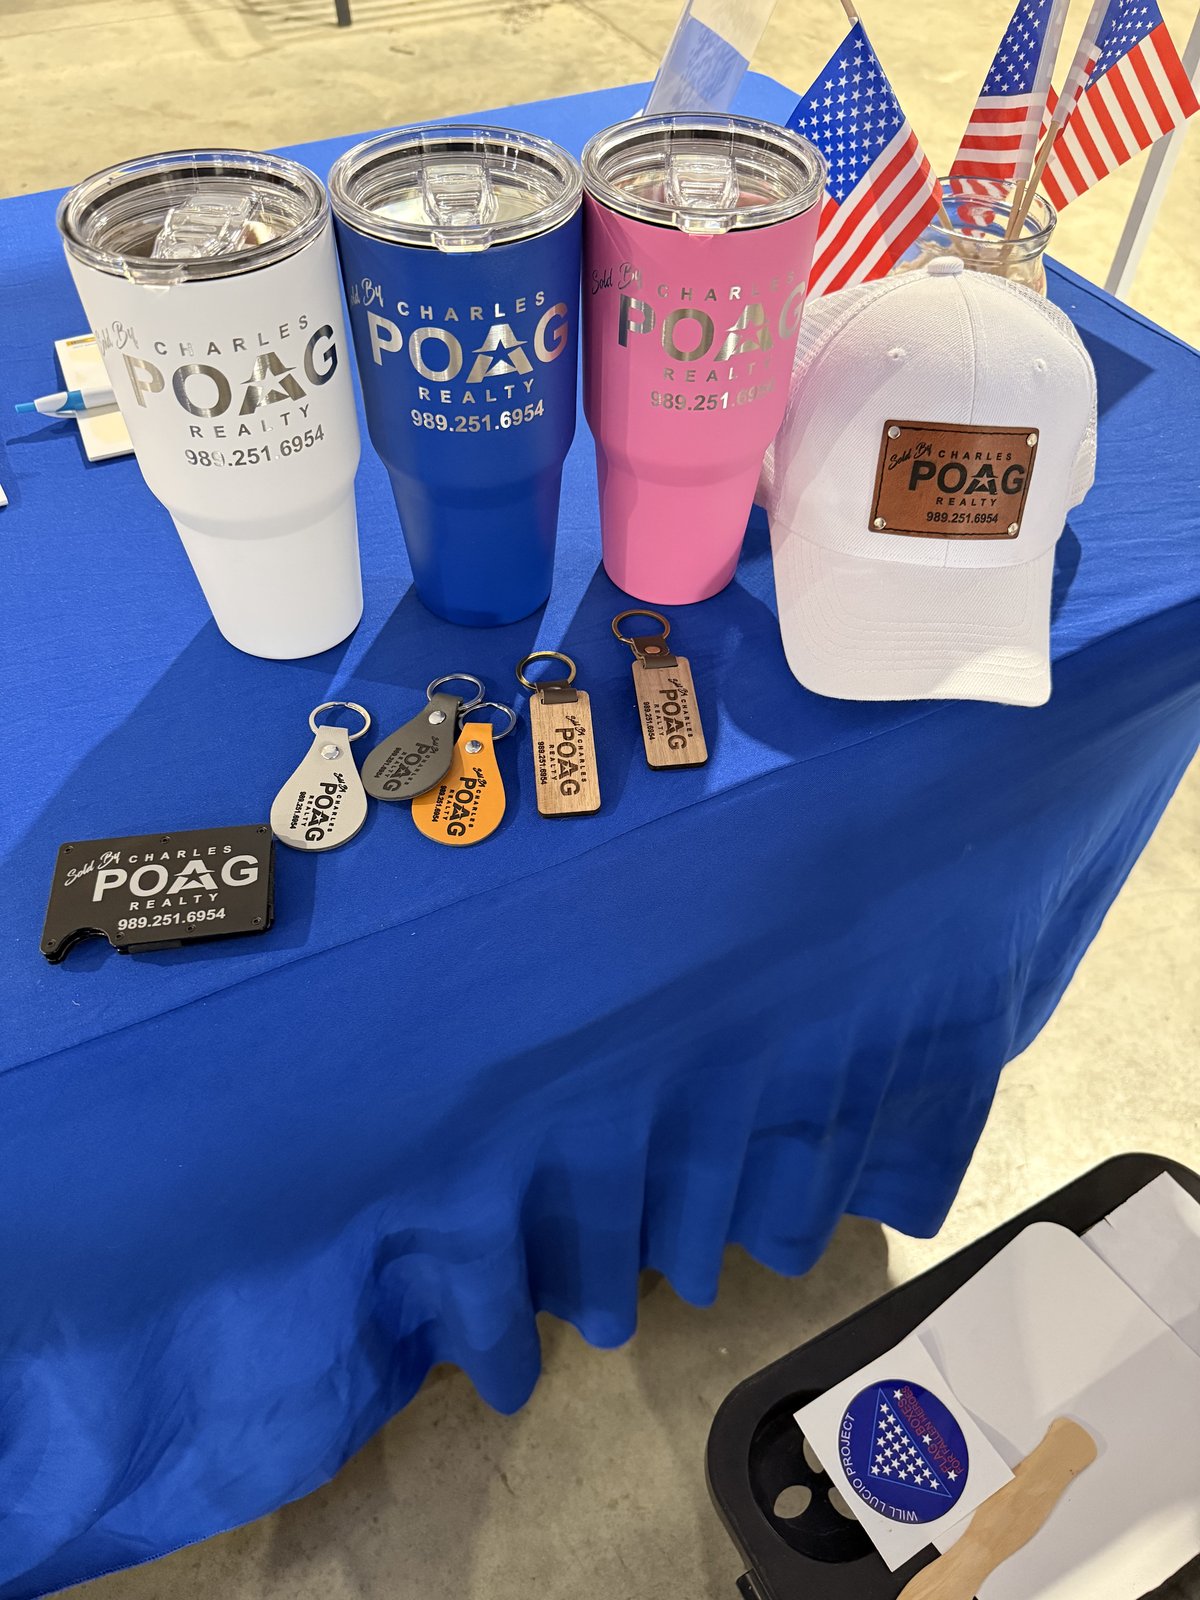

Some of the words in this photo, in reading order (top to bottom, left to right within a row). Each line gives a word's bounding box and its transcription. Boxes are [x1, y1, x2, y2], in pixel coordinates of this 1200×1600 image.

[361, 277, 384, 308] By
[592, 268, 613, 295] Sold
[618, 261, 642, 290] By
[657, 271, 795, 302] CHARLES
[397, 291, 545, 322] CHARLES
[618, 281, 806, 362] POAG
[112, 320, 139, 350] By
[154, 314, 309, 356] CHARLES
[367, 302, 569, 384] POAG
[122, 324, 338, 418] POAG
[418, 378, 534, 404] REALTY
[189, 404, 310, 438] REALTY
[411, 398, 545, 433] 989.251.6954
[184, 424, 325, 467] 989.251.6954
[888, 448, 912, 471] Sold
[913, 441, 933, 459] By
[938, 449, 1013, 461] CHARLES
[908, 460, 1025, 496] POAG
[926, 511, 999, 524] 989.251.6954
[936, 497, 998, 507] REALTY
[654, 704, 664, 736] REALTY
[659, 689, 687, 750] POAG
[681, 699, 693, 738] CHARLES
[382, 742, 431, 792] POAG
[538, 741, 548, 785] 989.251.6954
[549, 744, 557, 780] REALTY
[555, 727, 580, 796] POAG
[577, 739, 587, 783] CHARLES
[301, 795, 314, 827] REALTY
[305, 782, 338, 841] POAG
[443, 789, 455, 821] REALTY
[447, 777, 477, 836] POAG
[64, 859, 94, 887] Sold
[98, 850, 121, 870] By
[128, 845, 232, 864] CHARLES
[92, 854, 259, 902] POAG
[129, 892, 219, 911] REALTY
[117, 907, 226, 931] 989.251.6954
[898, 1398, 926, 1436] BOXES
[901, 1385, 928, 1423] HEROES
[840, 1412, 856, 1476] PROJECT
[925, 1421, 951, 1455] FALLEN
[928, 1443, 952, 1473] FLAG
[947, 1452, 965, 1474] FOR
[852, 1478, 886, 1512] LUCIO
[889, 1506, 918, 1522] WILL
